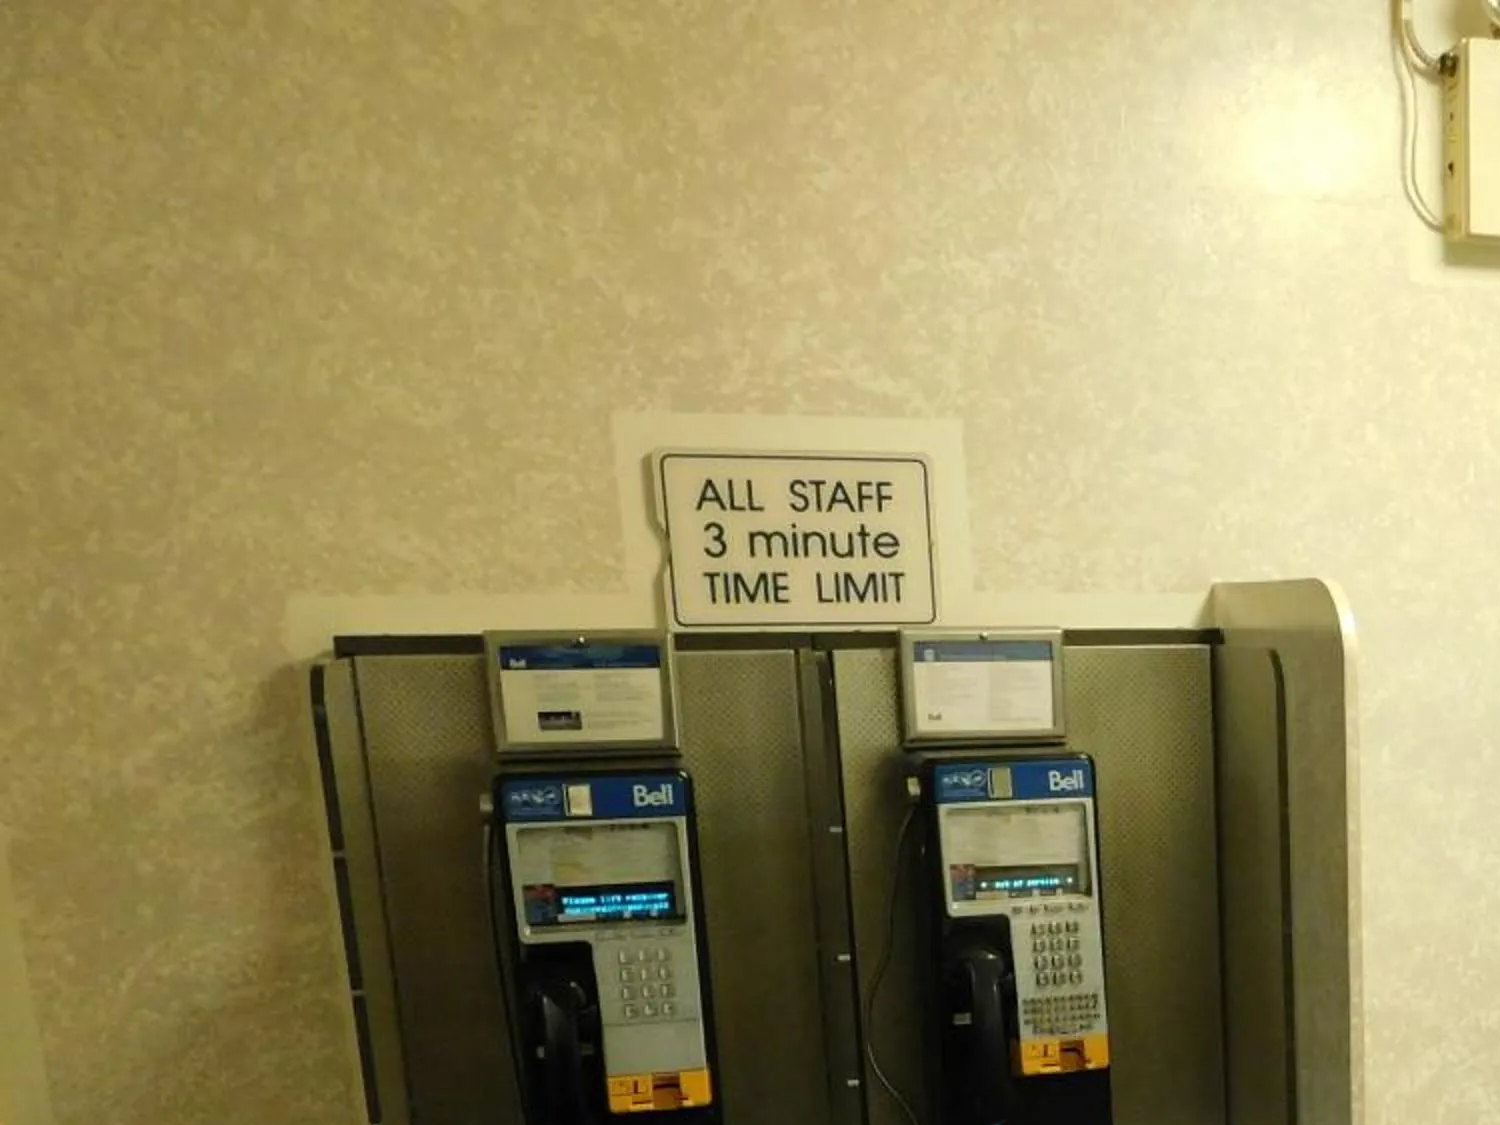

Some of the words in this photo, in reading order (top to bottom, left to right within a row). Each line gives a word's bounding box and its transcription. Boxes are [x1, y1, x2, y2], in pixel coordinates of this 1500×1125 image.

[696, 478, 765, 512] ALL
[789, 479, 894, 513] STAFF
[702, 522, 728, 558] 3
[748, 522, 901, 559] minute
[703, 571, 791, 605] TIME
[815, 571, 906, 604] LIMIT
[632, 783, 675, 808] Bell
[1047, 769, 1084, 792] Bell
